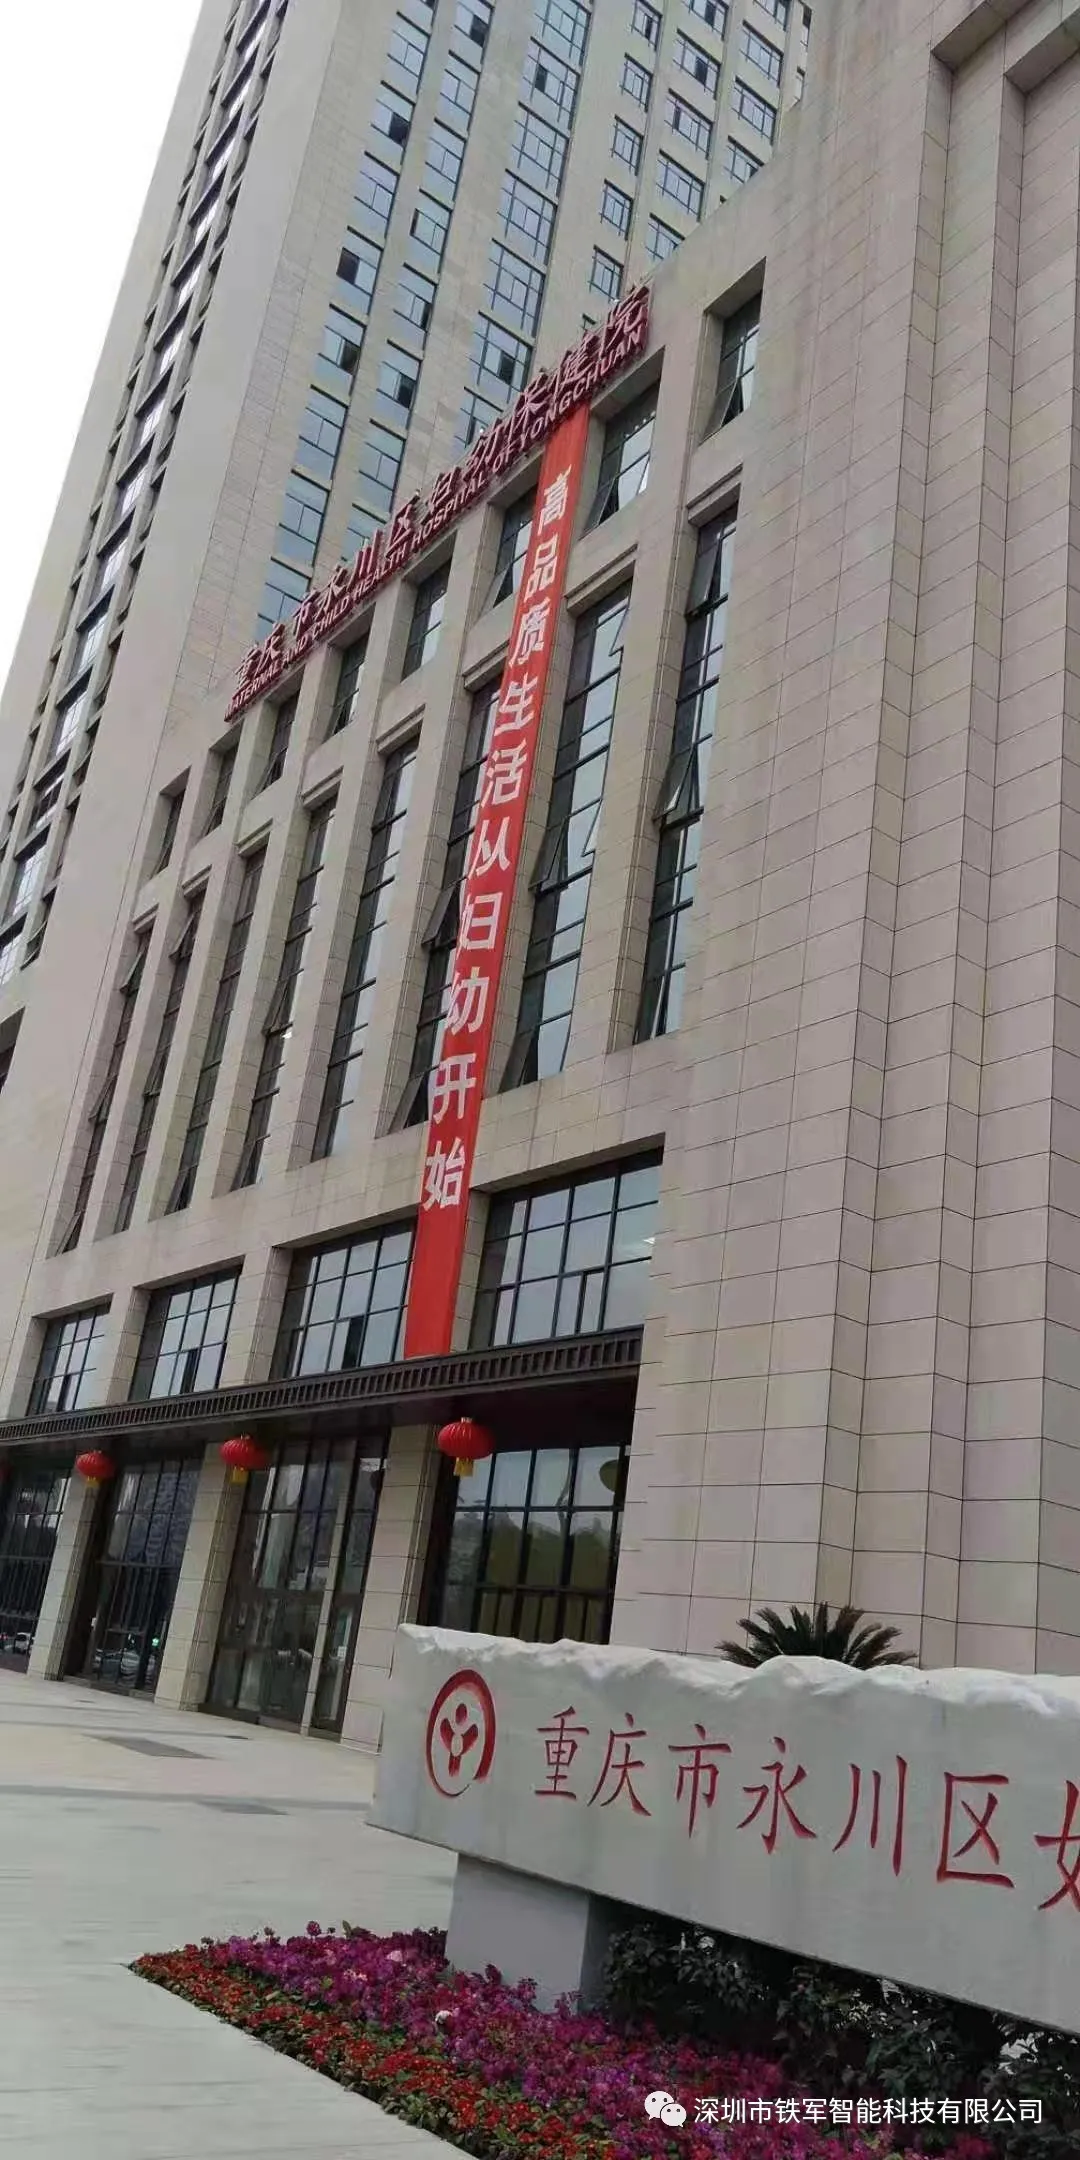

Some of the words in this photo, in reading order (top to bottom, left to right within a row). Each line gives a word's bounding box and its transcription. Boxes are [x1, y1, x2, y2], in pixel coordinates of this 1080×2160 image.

[235, 284, 649, 692] 重庆市永川区妇幼保健院
[312, 595, 351, 638] CHILD
[353, 541, 407, 600] HEALTH
[411, 471, 486, 553] HOSPITAL
[493, 442, 516, 473] OF
[518, 323, 645, 452] YONGCHUAN
[423, 464, 572, 1211] 高品质生活从妇幼开始
